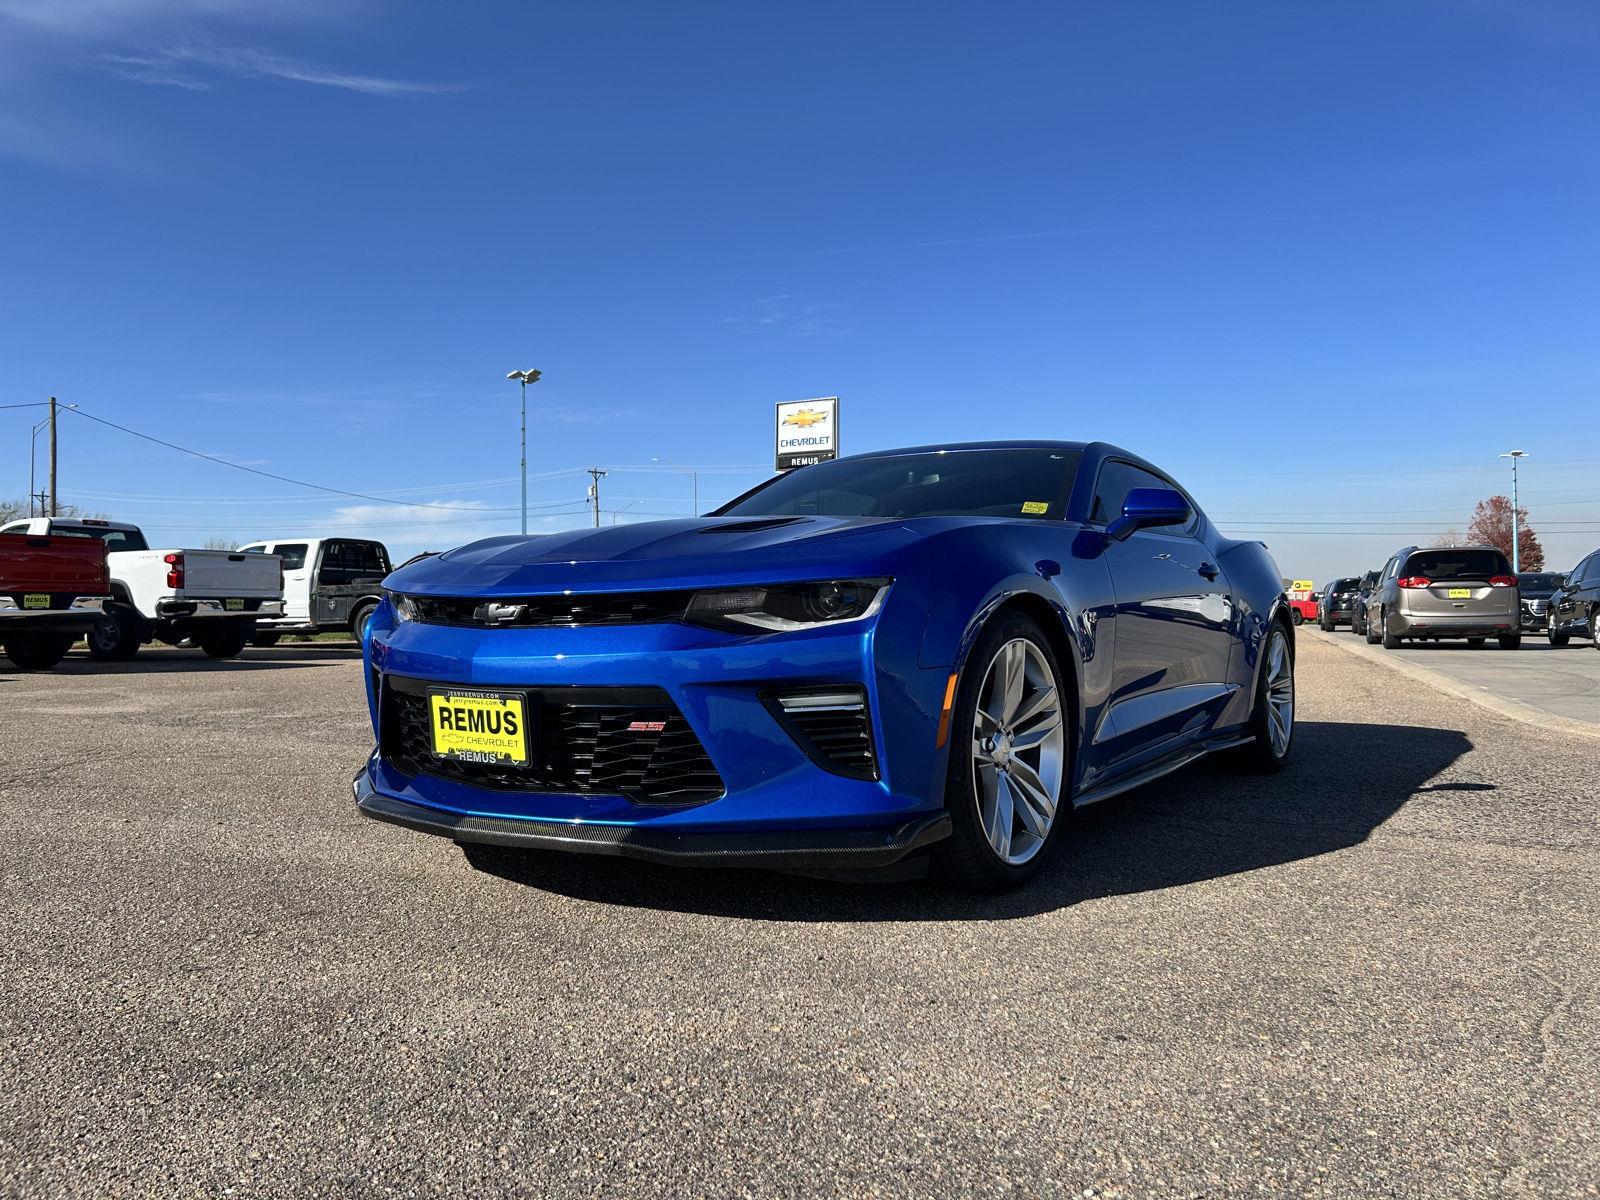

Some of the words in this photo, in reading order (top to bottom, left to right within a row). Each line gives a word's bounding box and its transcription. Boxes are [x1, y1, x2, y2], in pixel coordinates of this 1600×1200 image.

[780, 435, 830, 448] CHEVROLET
[791, 457, 819, 466] REMUS
[438, 706, 518, 735] REMUS
[466, 736, 519, 748] CHEVROLET
[459, 751, 497, 764] REMUS
